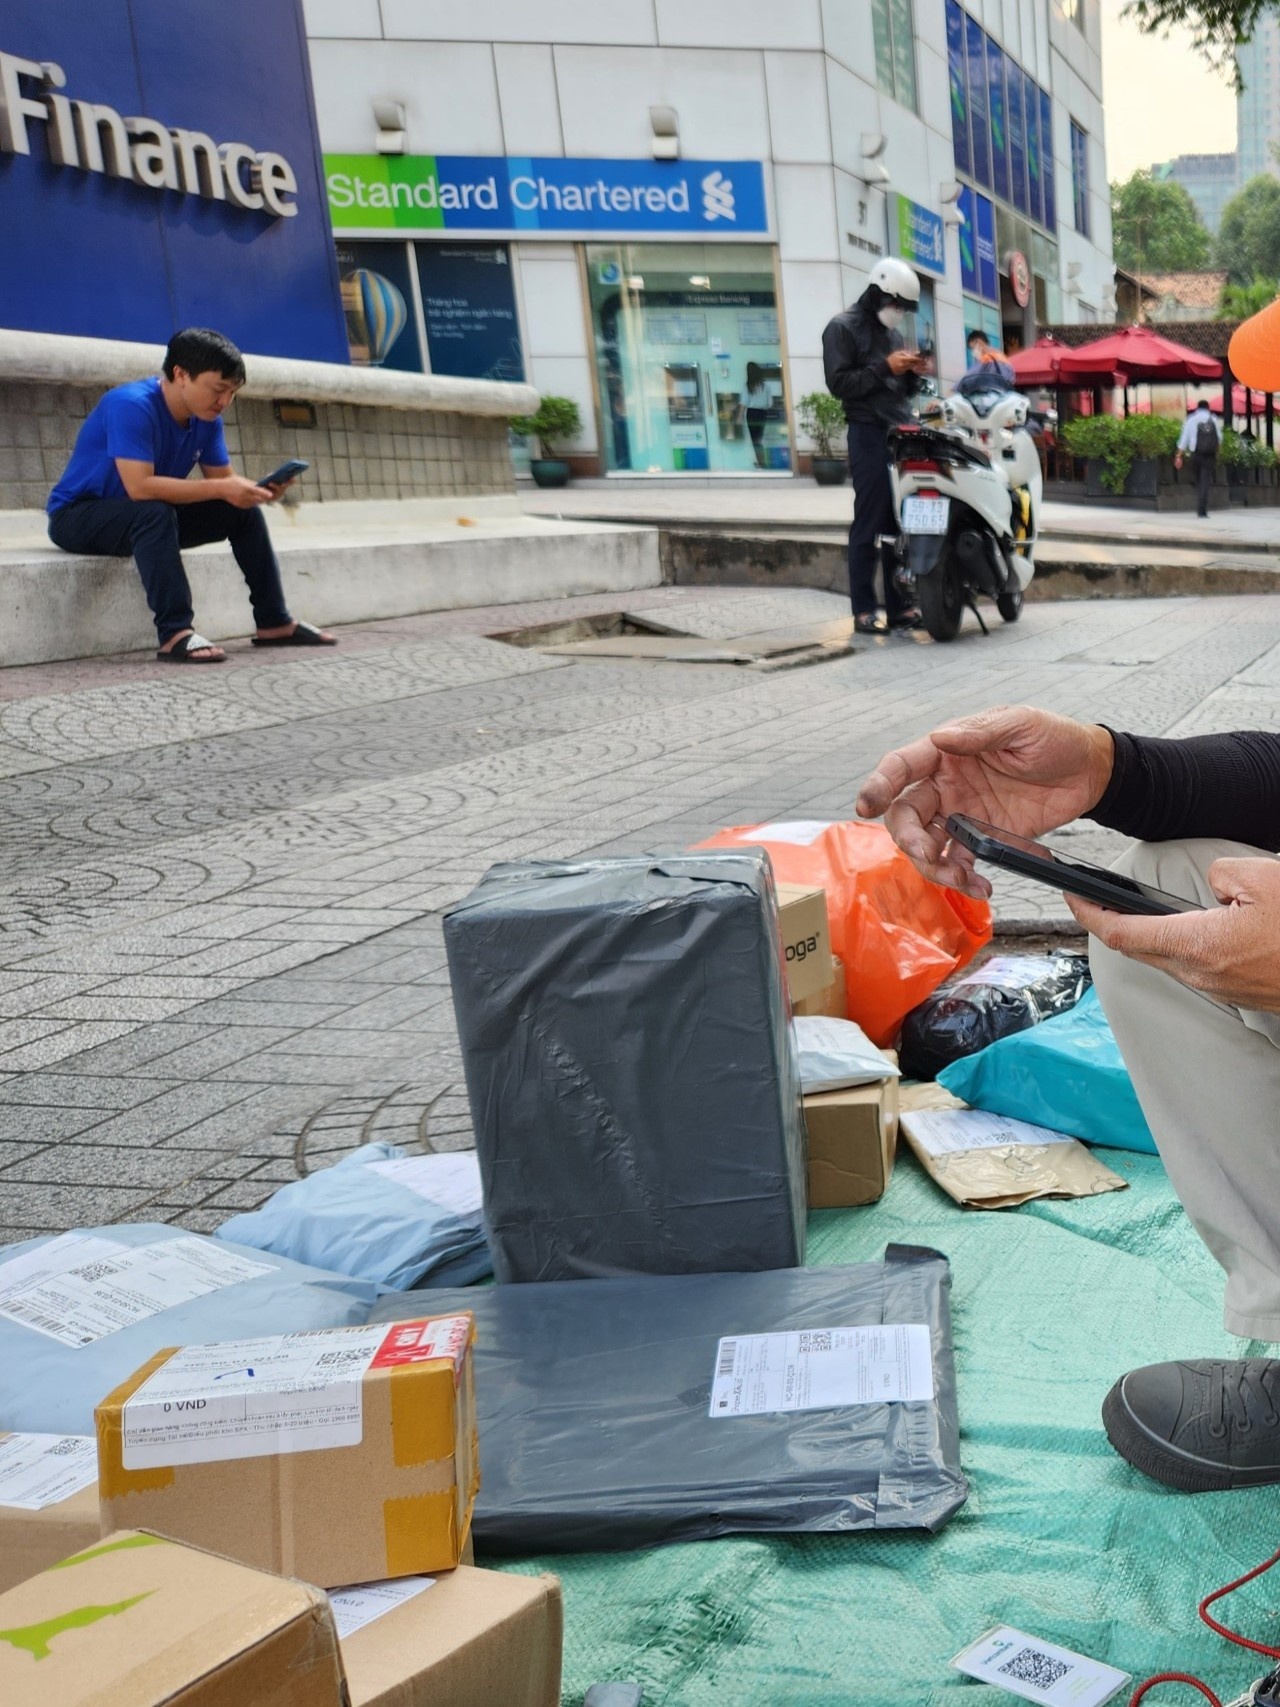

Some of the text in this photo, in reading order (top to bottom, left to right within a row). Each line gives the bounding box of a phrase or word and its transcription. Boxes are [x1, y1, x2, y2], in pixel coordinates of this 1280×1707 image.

[0, 52, 298, 218] Finance
[326, 173, 690, 213] Standard Chartered
[785, 936, 817, 962] oga
[163, 1399, 207, 1412] 0 VND
